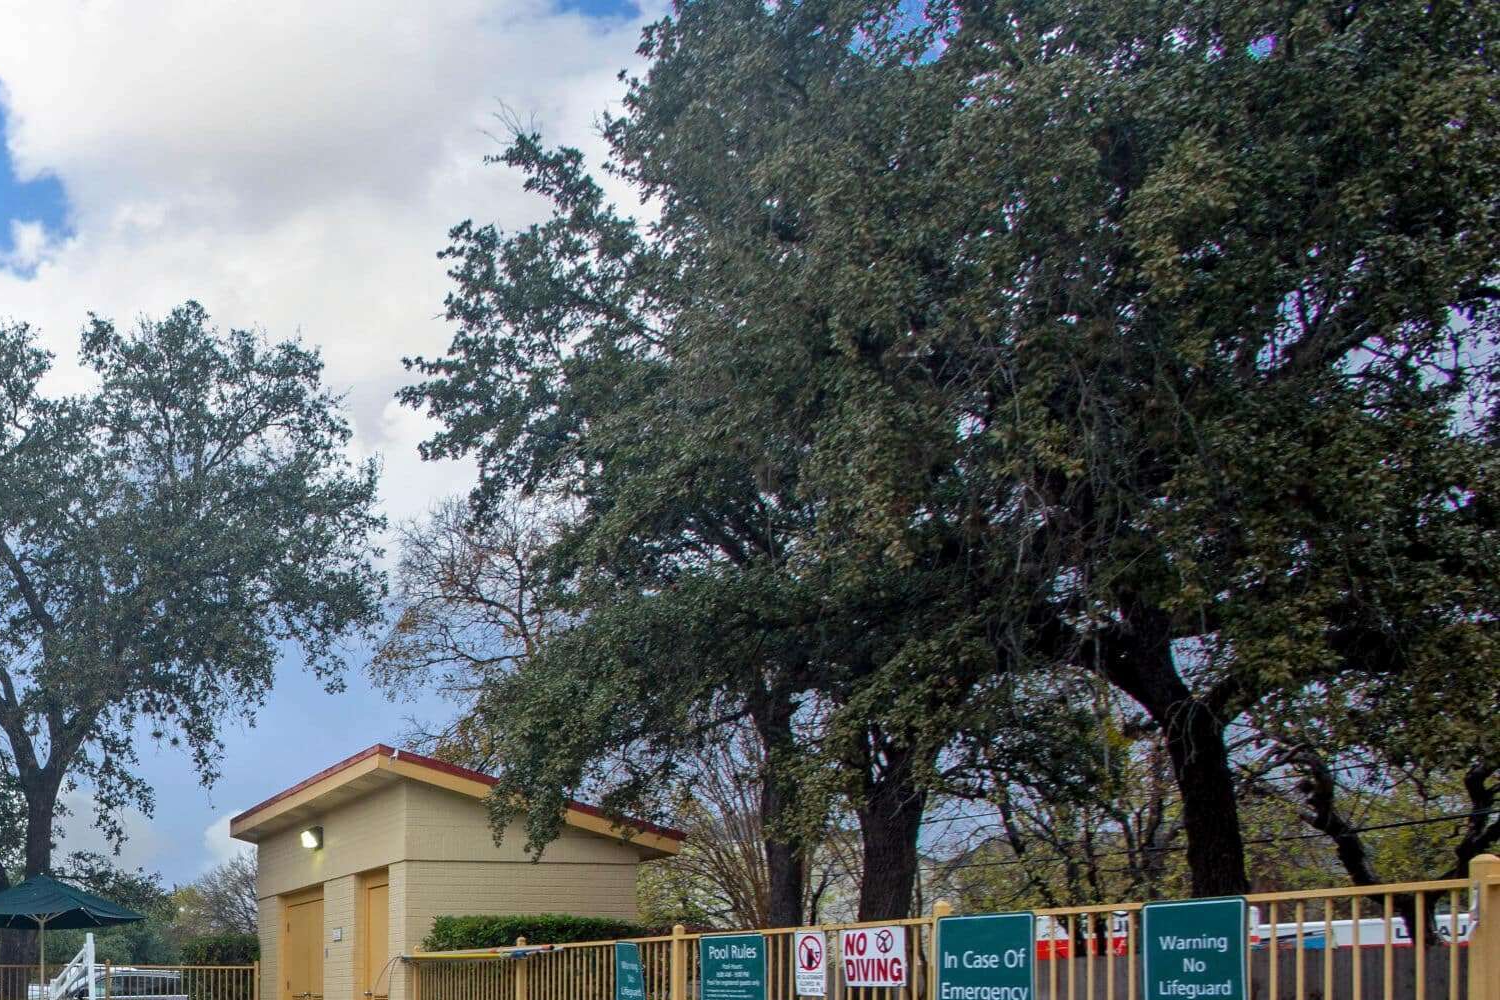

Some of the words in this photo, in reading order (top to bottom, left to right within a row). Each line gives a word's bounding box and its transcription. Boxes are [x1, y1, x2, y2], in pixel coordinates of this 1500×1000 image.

[708, 944, 729, 959] Pool
[731, 943, 757, 959] Rules
[844, 932, 868, 956] NO
[1158, 933, 1228, 952] Warning
[944, 951, 958, 969] In
[962, 950, 999, 969] Case
[1004, 947, 1026, 969] Of
[1182, 957, 1206, 973] No
[845, 957, 903, 982] DIVING
[1159, 979, 1232, 999] Lifeguard
